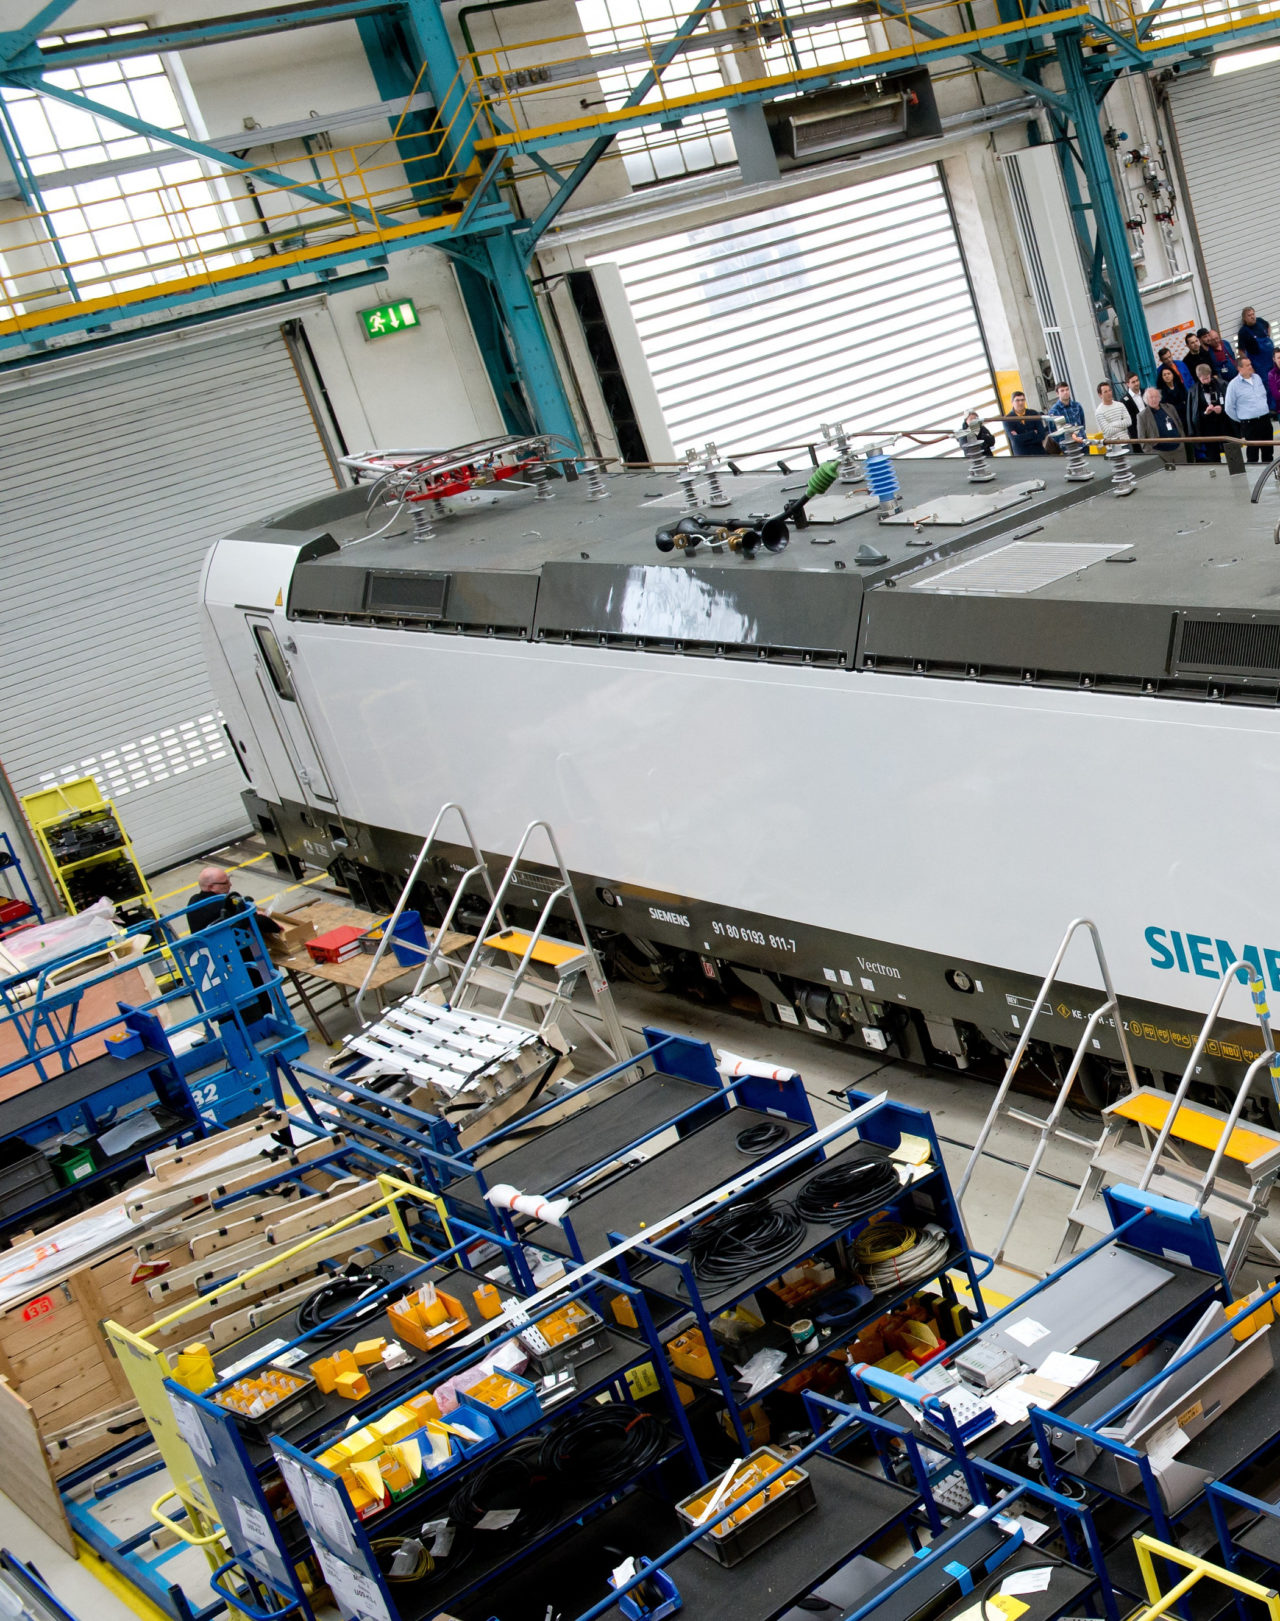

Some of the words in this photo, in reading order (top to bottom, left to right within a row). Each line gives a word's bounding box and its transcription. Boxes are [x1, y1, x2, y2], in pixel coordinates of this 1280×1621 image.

[649, 907, 691, 928] SIEMENS
[712, 920, 725, 936] 91
[725, 924, 740, 939] 80
[740, 927, 766, 946] 6193
[768, 934, 796, 953] 811-7
[856, 956, 902, 979] Vectron
